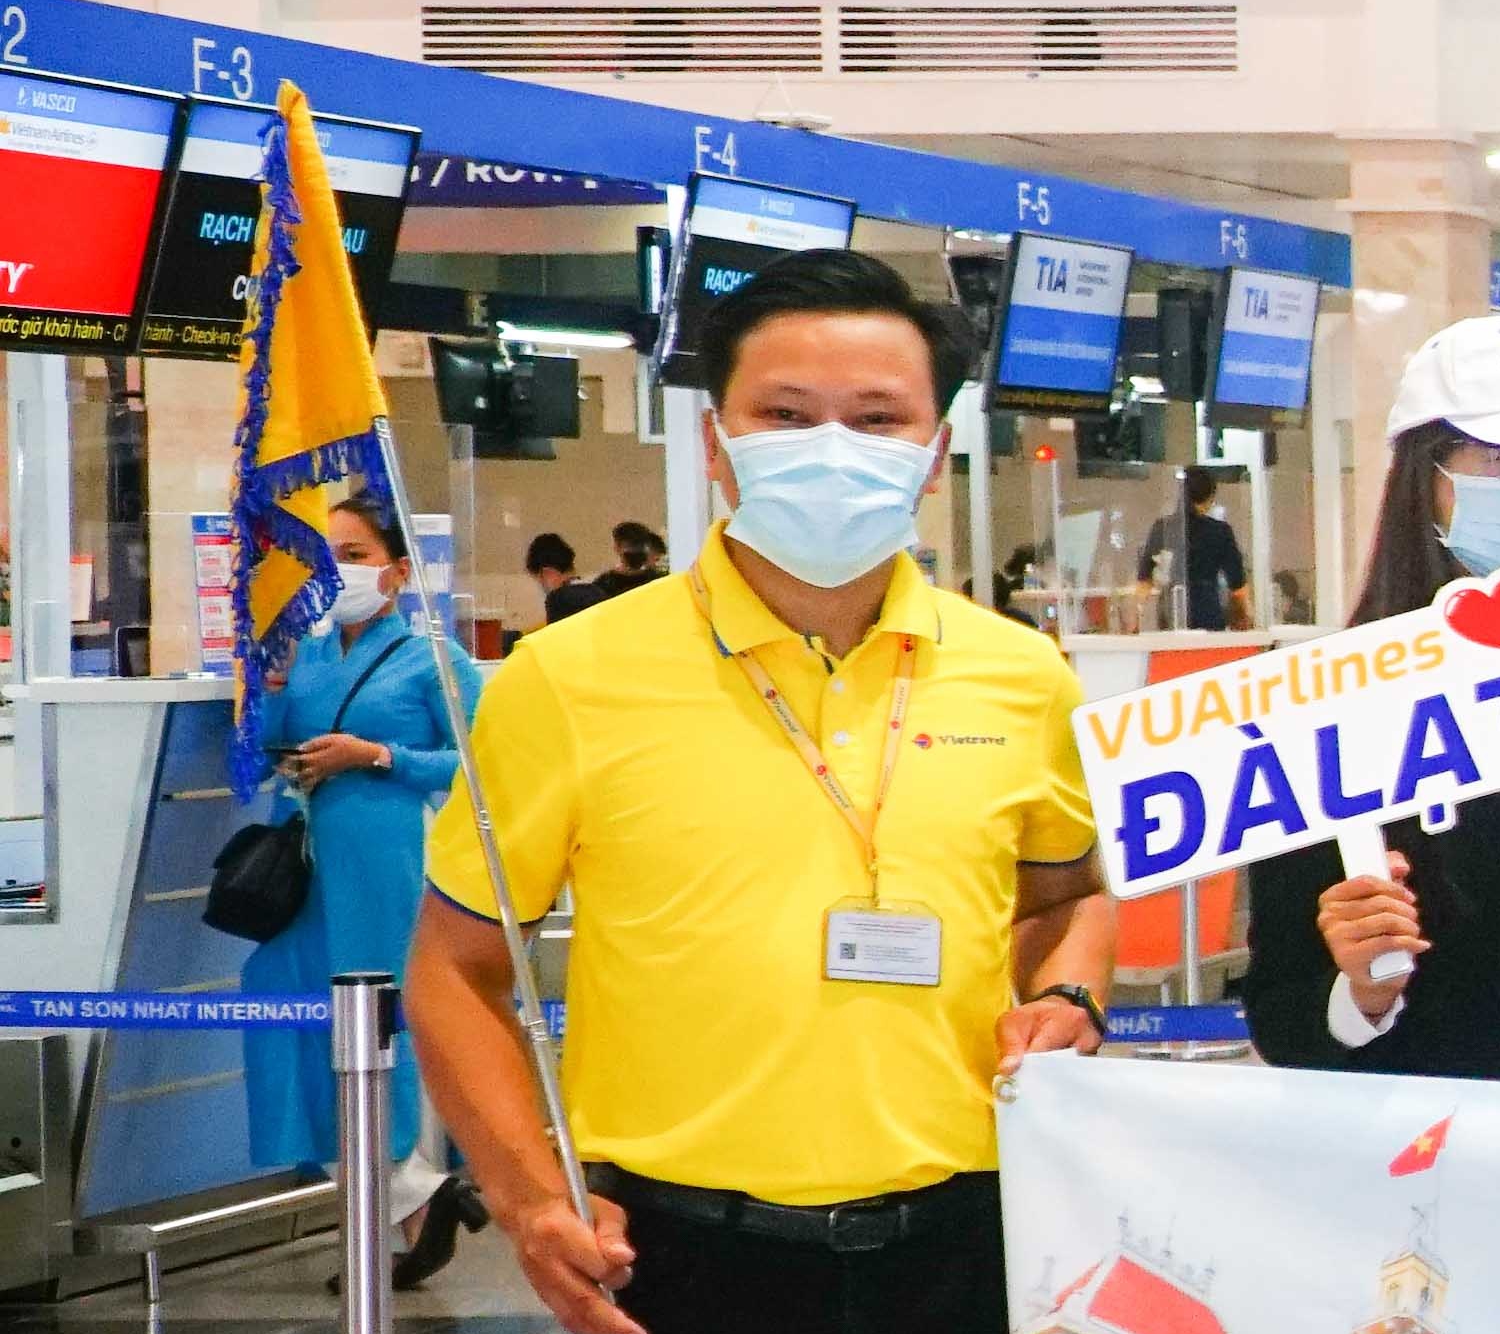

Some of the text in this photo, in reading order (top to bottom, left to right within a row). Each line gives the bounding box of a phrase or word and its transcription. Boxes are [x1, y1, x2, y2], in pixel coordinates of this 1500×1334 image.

[191, 37, 255, 101] F-3
[694, 125, 738, 177] F-4
[1016, 181, 1052, 226] F-5
[1219, 219, 1250, 260] F-6
[1035, 255, 1068, 295] TIA
[1086, 628, 1448, 762] VUAirlines
[30, 998, 74, 1020] TAN
[79, 999, 128, 1021] SON
[132, 1000, 193, 1022] NHAT
